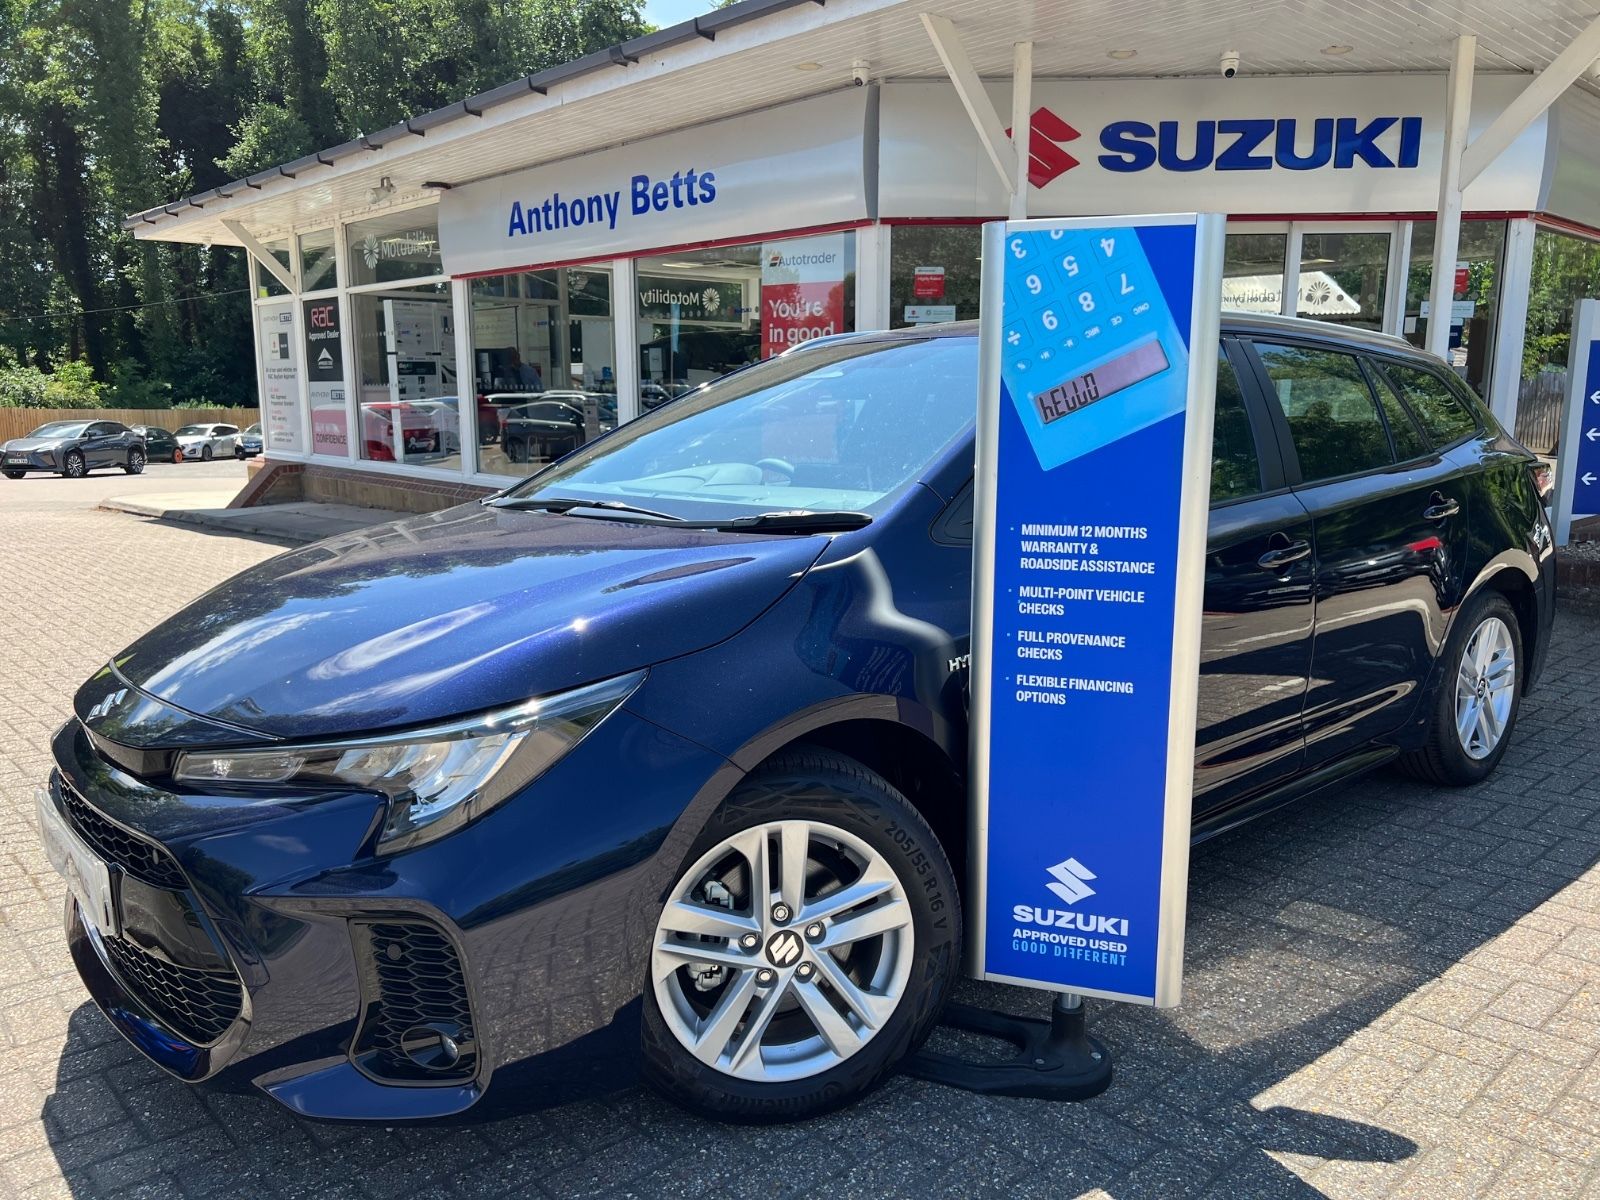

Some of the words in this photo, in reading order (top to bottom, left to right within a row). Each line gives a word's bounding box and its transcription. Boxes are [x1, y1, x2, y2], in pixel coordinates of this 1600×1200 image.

[1098, 117, 1422, 173] SUZUKI
[508, 191, 620, 237] Anthony
[632, 168, 716, 216] Betts
[778, 252, 836, 267] Autotrader
[769, 299, 824, 318] You're
[769, 323, 783, 342] in
[787, 321, 834, 346] good
[1021, 524, 1079, 537] MINIMUM
[1080, 526, 1092, 538] 12
[1094, 526, 1148, 539] MONTHS
[1021, 541, 1088, 554] WARRANTY
[1089, 543, 1099, 555] &
[1020, 558, 1078, 571] ROADSIDE
[1080, 560, 1155, 574] ASSISTANCE
[1019, 586, 1094, 600] MULTI-POINT
[1095, 590, 1145, 603] VEHICLE
[1019, 602, 1064, 616] CHECKS
[1017, 630, 1045, 643] FULL
[1046, 632, 1126, 648] PROVENANCE
[1017, 647, 1063, 661] CHECKS
[1016, 674, 1068, 689] FLEXIBLE
[1069, 678, 1134, 694] FINANCING
[1016, 690, 1066, 705] OPTIONS
[884, 821, 931, 876] 205/55
[1012, 904, 1129, 936] SUZUKI
[1012, 928, 1087, 947] APPROVED
[1089, 939, 1127, 953] USED
[1012, 939, 1047, 955] GOOD
[1054, 945, 1127, 966] DIFFERENT
